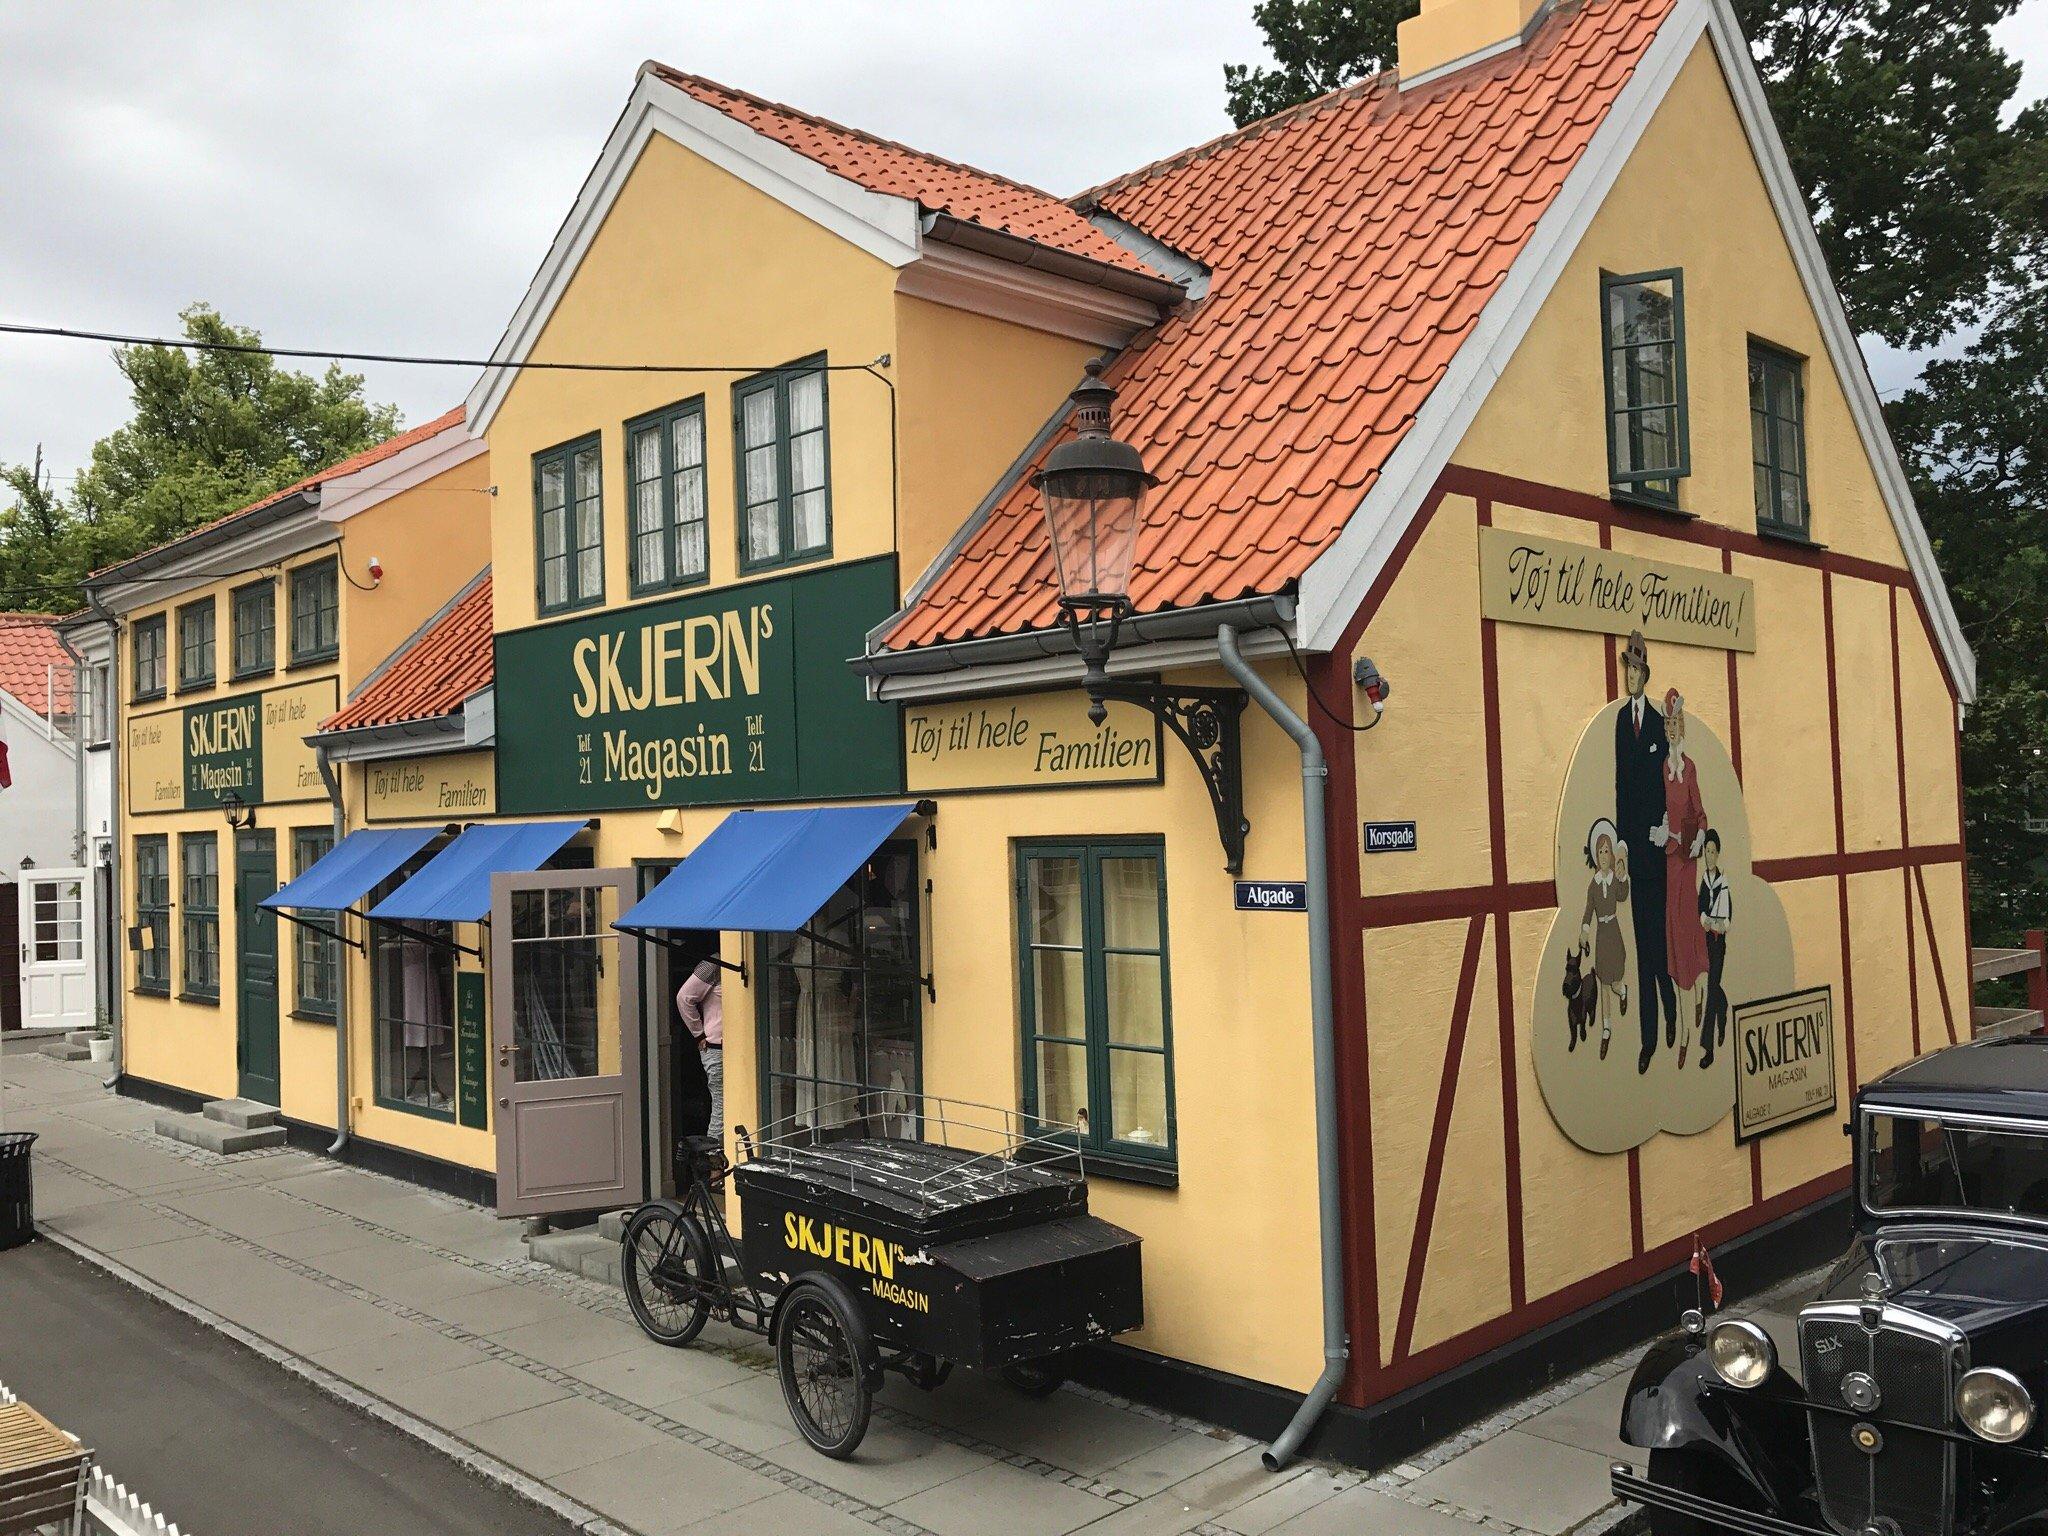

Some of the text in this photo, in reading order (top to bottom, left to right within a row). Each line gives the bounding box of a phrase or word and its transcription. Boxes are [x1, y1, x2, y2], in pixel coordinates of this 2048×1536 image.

[1508, 546, 1746, 638] Tøj til hele Familien!
[288, 696, 307, 721] hele
[745, 713, 766, 736] Telf.
[910, 706, 1029, 762] Tøj til hele
[603, 722, 733, 800] Magasin
[748, 740, 766, 772] 21
[1034, 725, 1152, 773] Familien
[200, 760, 243, 799] Magasin
[374, 765, 425, 800] Tøj til hele
[578, 756, 593, 785] 21
[438, 780, 487, 808] Familien
[1369, 827, 1414, 848] Korsgade
[1247, 886, 1294, 907] Algade
[1768, 1065, 1809, 1091] MAGASIN
[872, 1277, 929, 1314] MAGASIN
[1814, 1334, 1843, 1354] SIX
